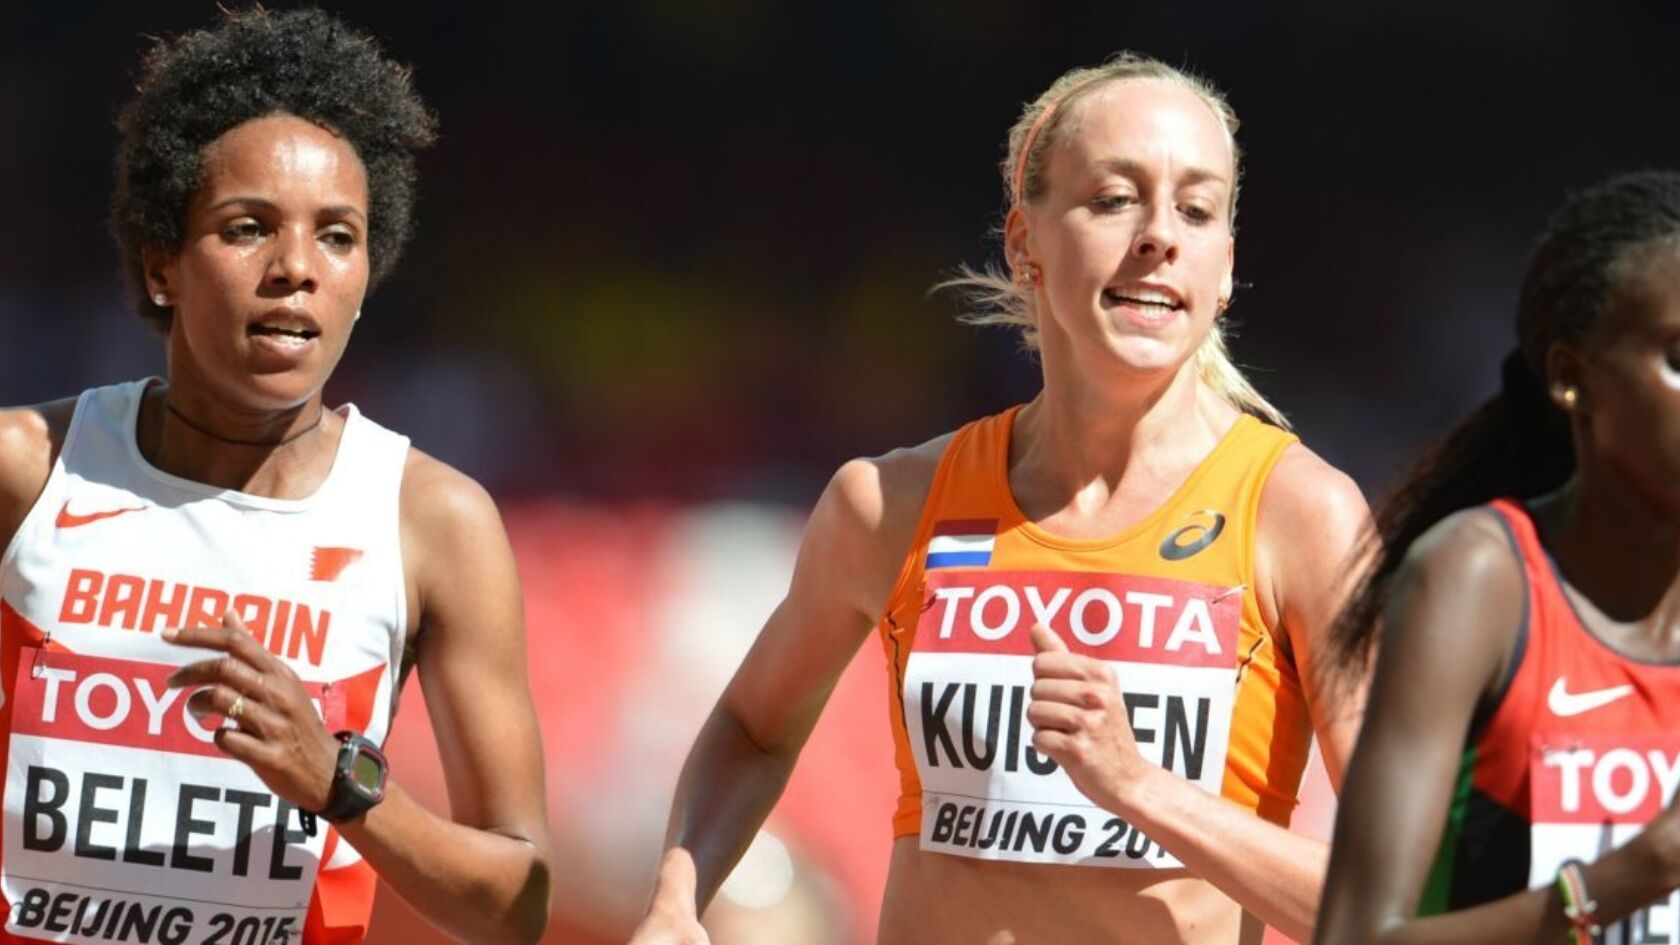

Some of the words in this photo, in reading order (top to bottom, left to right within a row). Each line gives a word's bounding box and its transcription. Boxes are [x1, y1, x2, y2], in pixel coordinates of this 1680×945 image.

[58, 568, 331, 667] BAHRAIN
[933, 584, 1223, 655] TOYOTA
[920, 682, 1211, 780] KUIEN
[22, 765, 308, 881] BELETE
[931, 802, 1087, 855] BEIJING
[1094, 817, 1165, 859] 20
[15, 888, 194, 945] BEIJING
